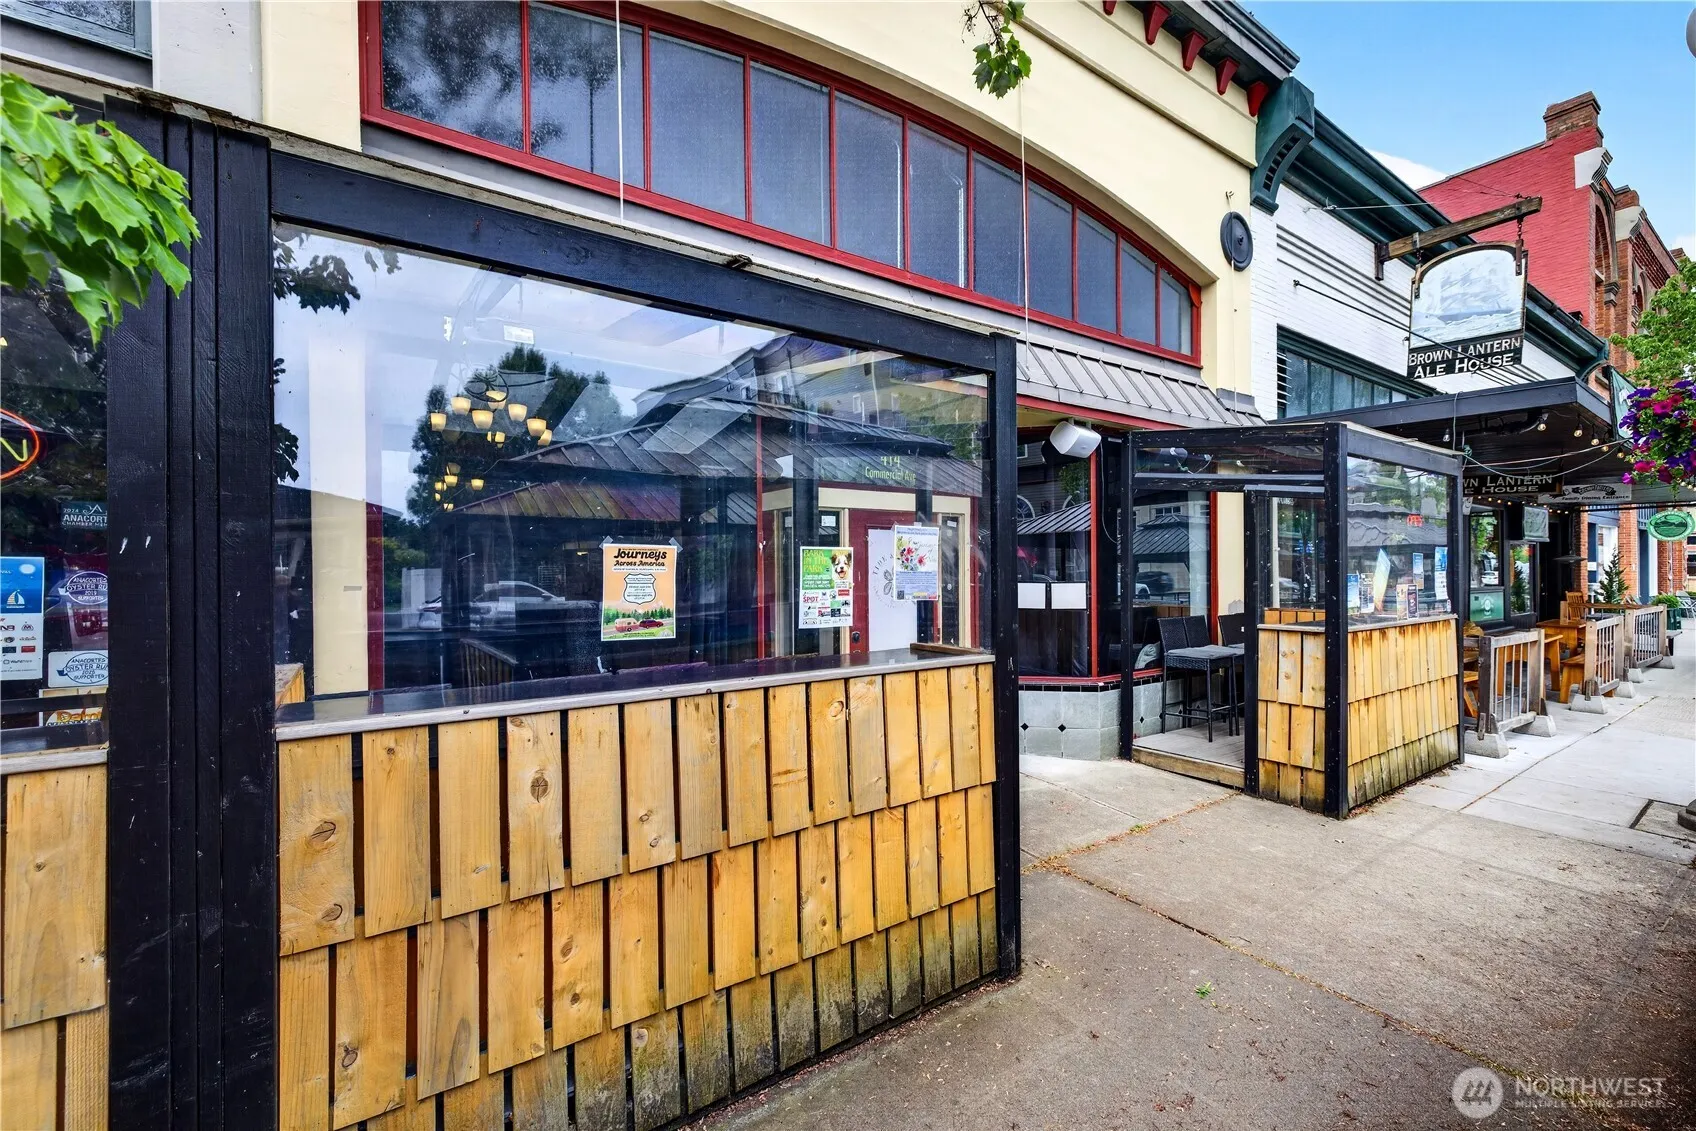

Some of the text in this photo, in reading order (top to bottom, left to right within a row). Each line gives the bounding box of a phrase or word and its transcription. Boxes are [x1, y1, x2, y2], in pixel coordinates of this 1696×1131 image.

[1408, 337, 1521, 367] BROWN LANTERN
[1413, 353, 1514, 379] ALE HOUSE
[865, 466, 903, 480] Commercial
[1486, 474, 1553, 487] LANTERN
[1481, 485, 1539, 494] HOUSE
[63, 514, 108, 523] ANACORT
[613, 548, 668, 561] Journeys
[66, 583, 96, 591] OYSTER
[65, 663, 94, 673] OYSTER
